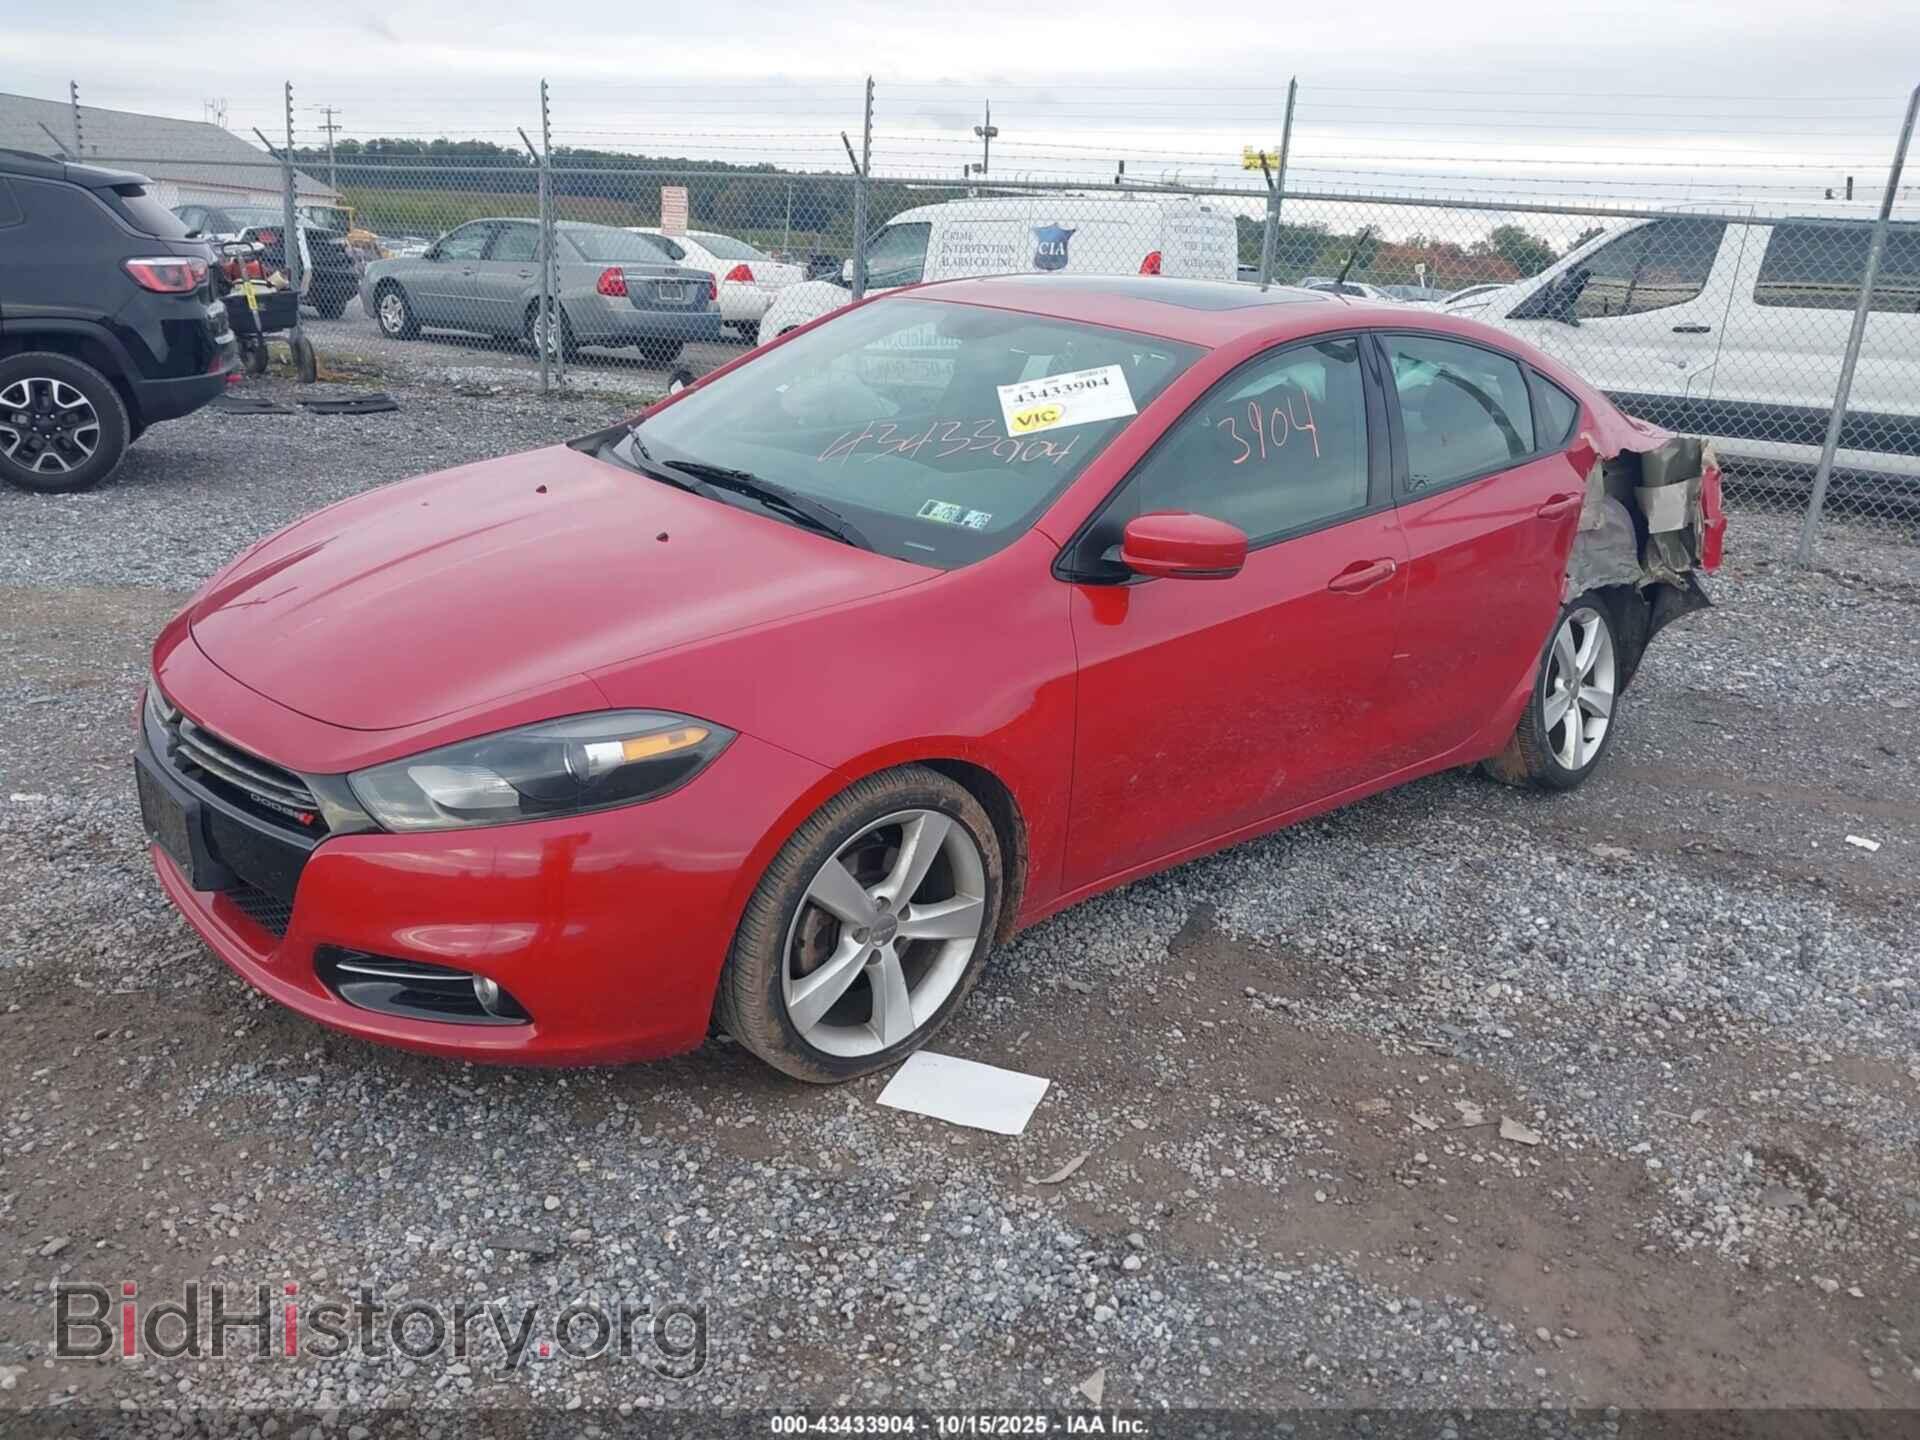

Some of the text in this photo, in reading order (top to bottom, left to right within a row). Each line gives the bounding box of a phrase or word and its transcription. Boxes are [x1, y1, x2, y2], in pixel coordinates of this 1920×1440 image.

[942, 243, 1016, 254] INTERVENTION
[1039, 241, 1065, 255] CIA
[1014, 377, 1110, 403] 43433904
[1017, 410, 1057, 426] VIC
[1217, 386, 1321, 464] 3904
